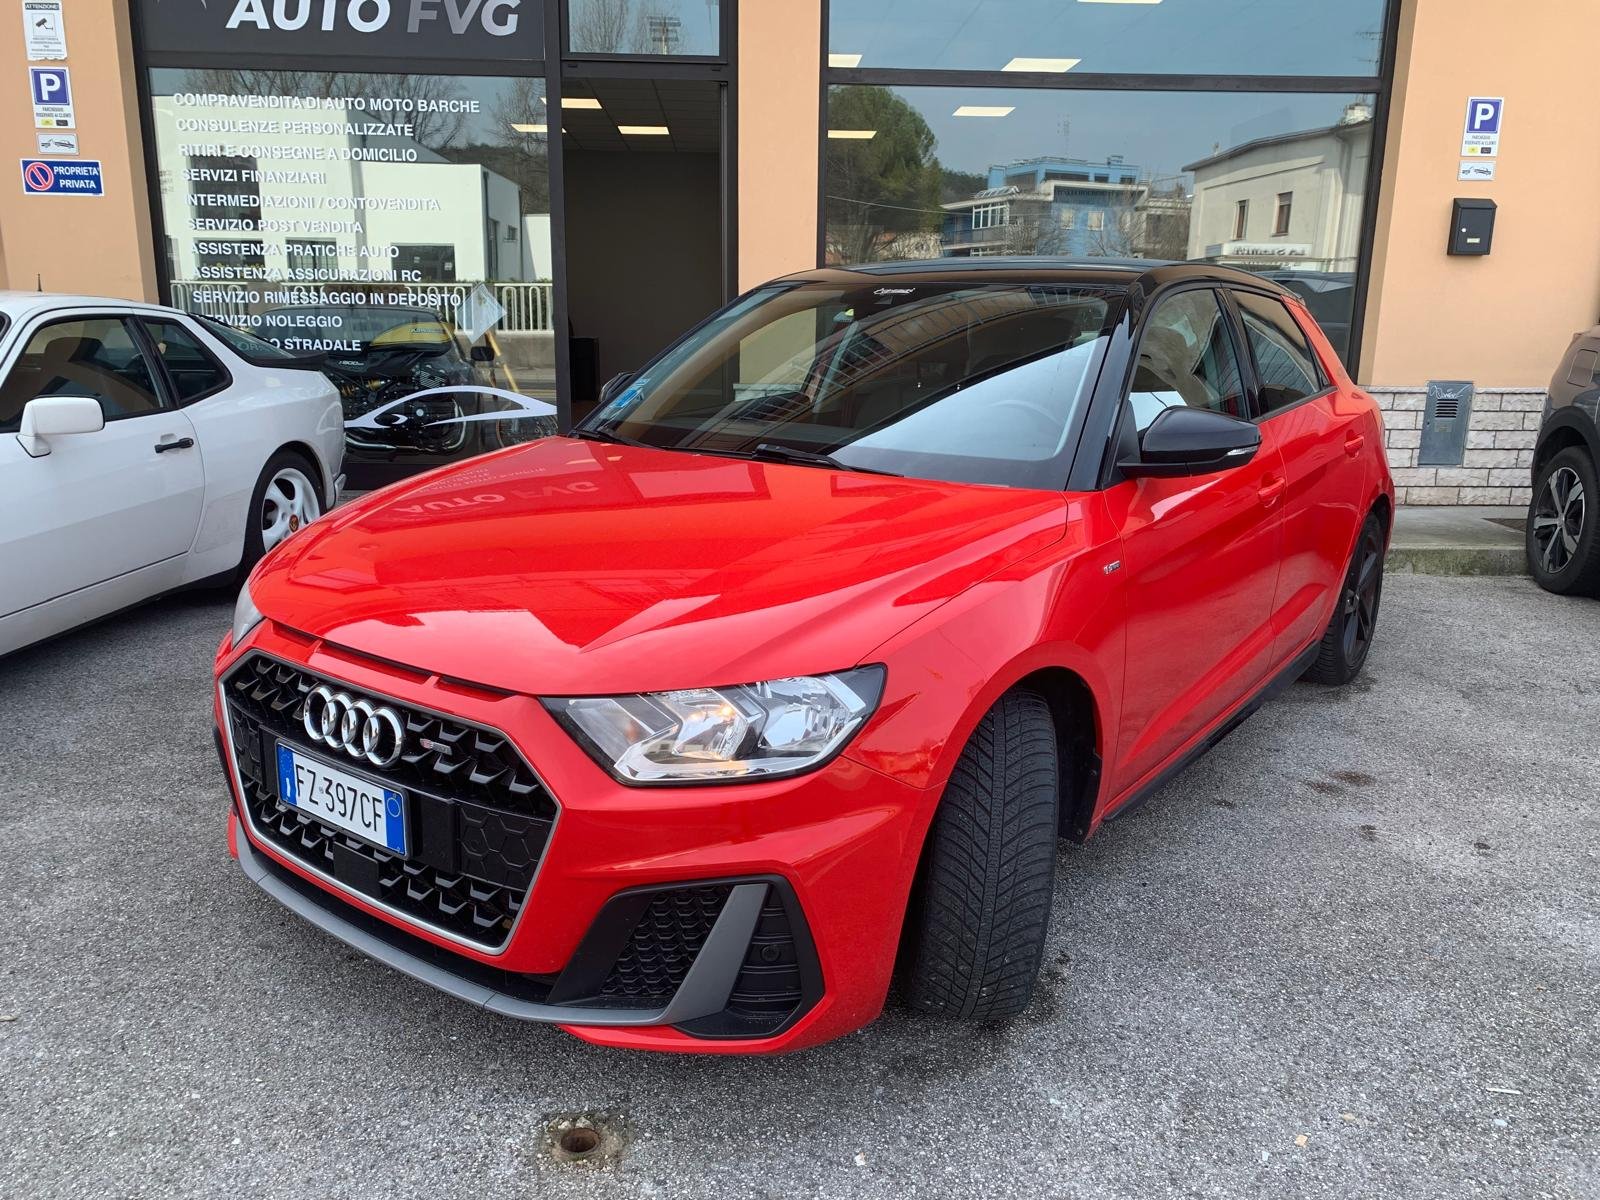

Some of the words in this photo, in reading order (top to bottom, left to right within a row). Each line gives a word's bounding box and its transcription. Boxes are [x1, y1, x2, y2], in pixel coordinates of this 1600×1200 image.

[225, 0, 391, 33] AUTO
[407, 0, 521, 36] FVG
[39, 73, 61, 101] P
[173, 93, 302, 109] COMPRAVENDITA
[306, 97, 321, 109] DI
[325, 98, 366, 111] AUTO
[370, 98, 414, 112] MOTO
[417, 99, 480, 113] BARCHE
[1473, 103, 1495, 130] P
[176, 119, 280, 133] CONSULENZE
[283, 121, 414, 136] PERSONALIZZATE
[178, 144, 222, 157] RITIRI
[226, 145, 237, 157] E
[240, 145, 325, 159] CONSEGNE
[327, 147, 339, 160] A
[342, 147, 418, 161] DOMICILIO
[59, 179, 97, 189] PRIVATA
[182, 168, 238, 182] SERVIZI
[242, 170, 327, 184] FINANZIARI
[186, 193, 313, 208] INTERMEDIAZIONI
[326, 197, 441, 211] CONTOVENDITA
[187, 218, 254, 231] SERVIZIO
[257, 219, 299, 232] POST
[302, 221, 364, 233] VENDITA
[191, 242, 284, 256] ASSISTENZA
[285, 244, 356, 257] PRATICHE
[360, 245, 400, 258] AUTO
[192, 266, 285, 280] ASSISTENZA
[287, 268, 397, 281] ASSICURAZIONI
[401, 270, 422, 281] RC
[193, 291, 260, 304] SERVIZIO
[264, 291, 366, 304] RIMESSAGGIO
[370, 293, 384, 304] IN
[388, 293, 462, 306] DEPOSITO
[205, 314, 262, 327] RVIZIO
[266, 315, 343, 328] NOLEGGIO
[284, 338, 362, 351] STRADALE
